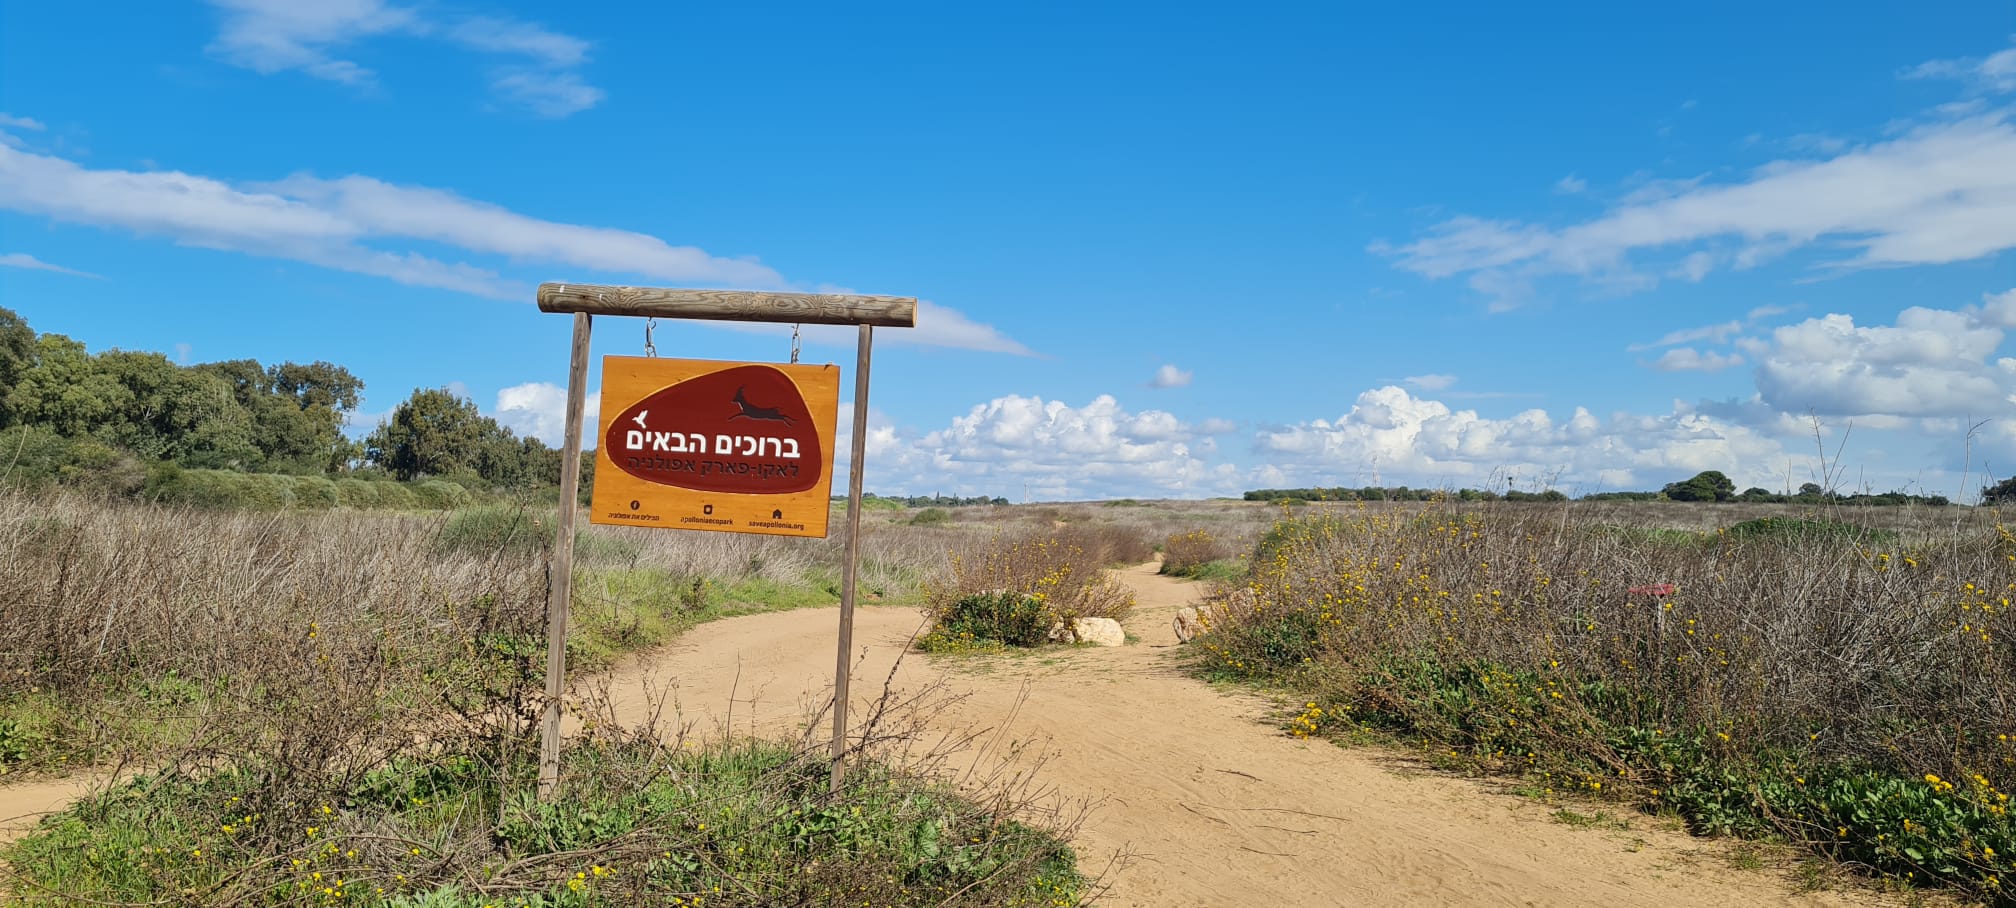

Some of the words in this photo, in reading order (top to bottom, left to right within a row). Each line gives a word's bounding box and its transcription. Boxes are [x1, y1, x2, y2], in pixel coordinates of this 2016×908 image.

[626, 429, 706, 453] הבאים
[715, 434, 801, 458] ברוכים
[627, 454, 696, 472] אפולניה
[701, 459, 800, 480] לאקו-פארק
[748, 521, 805, 531] saveapollonia.org
